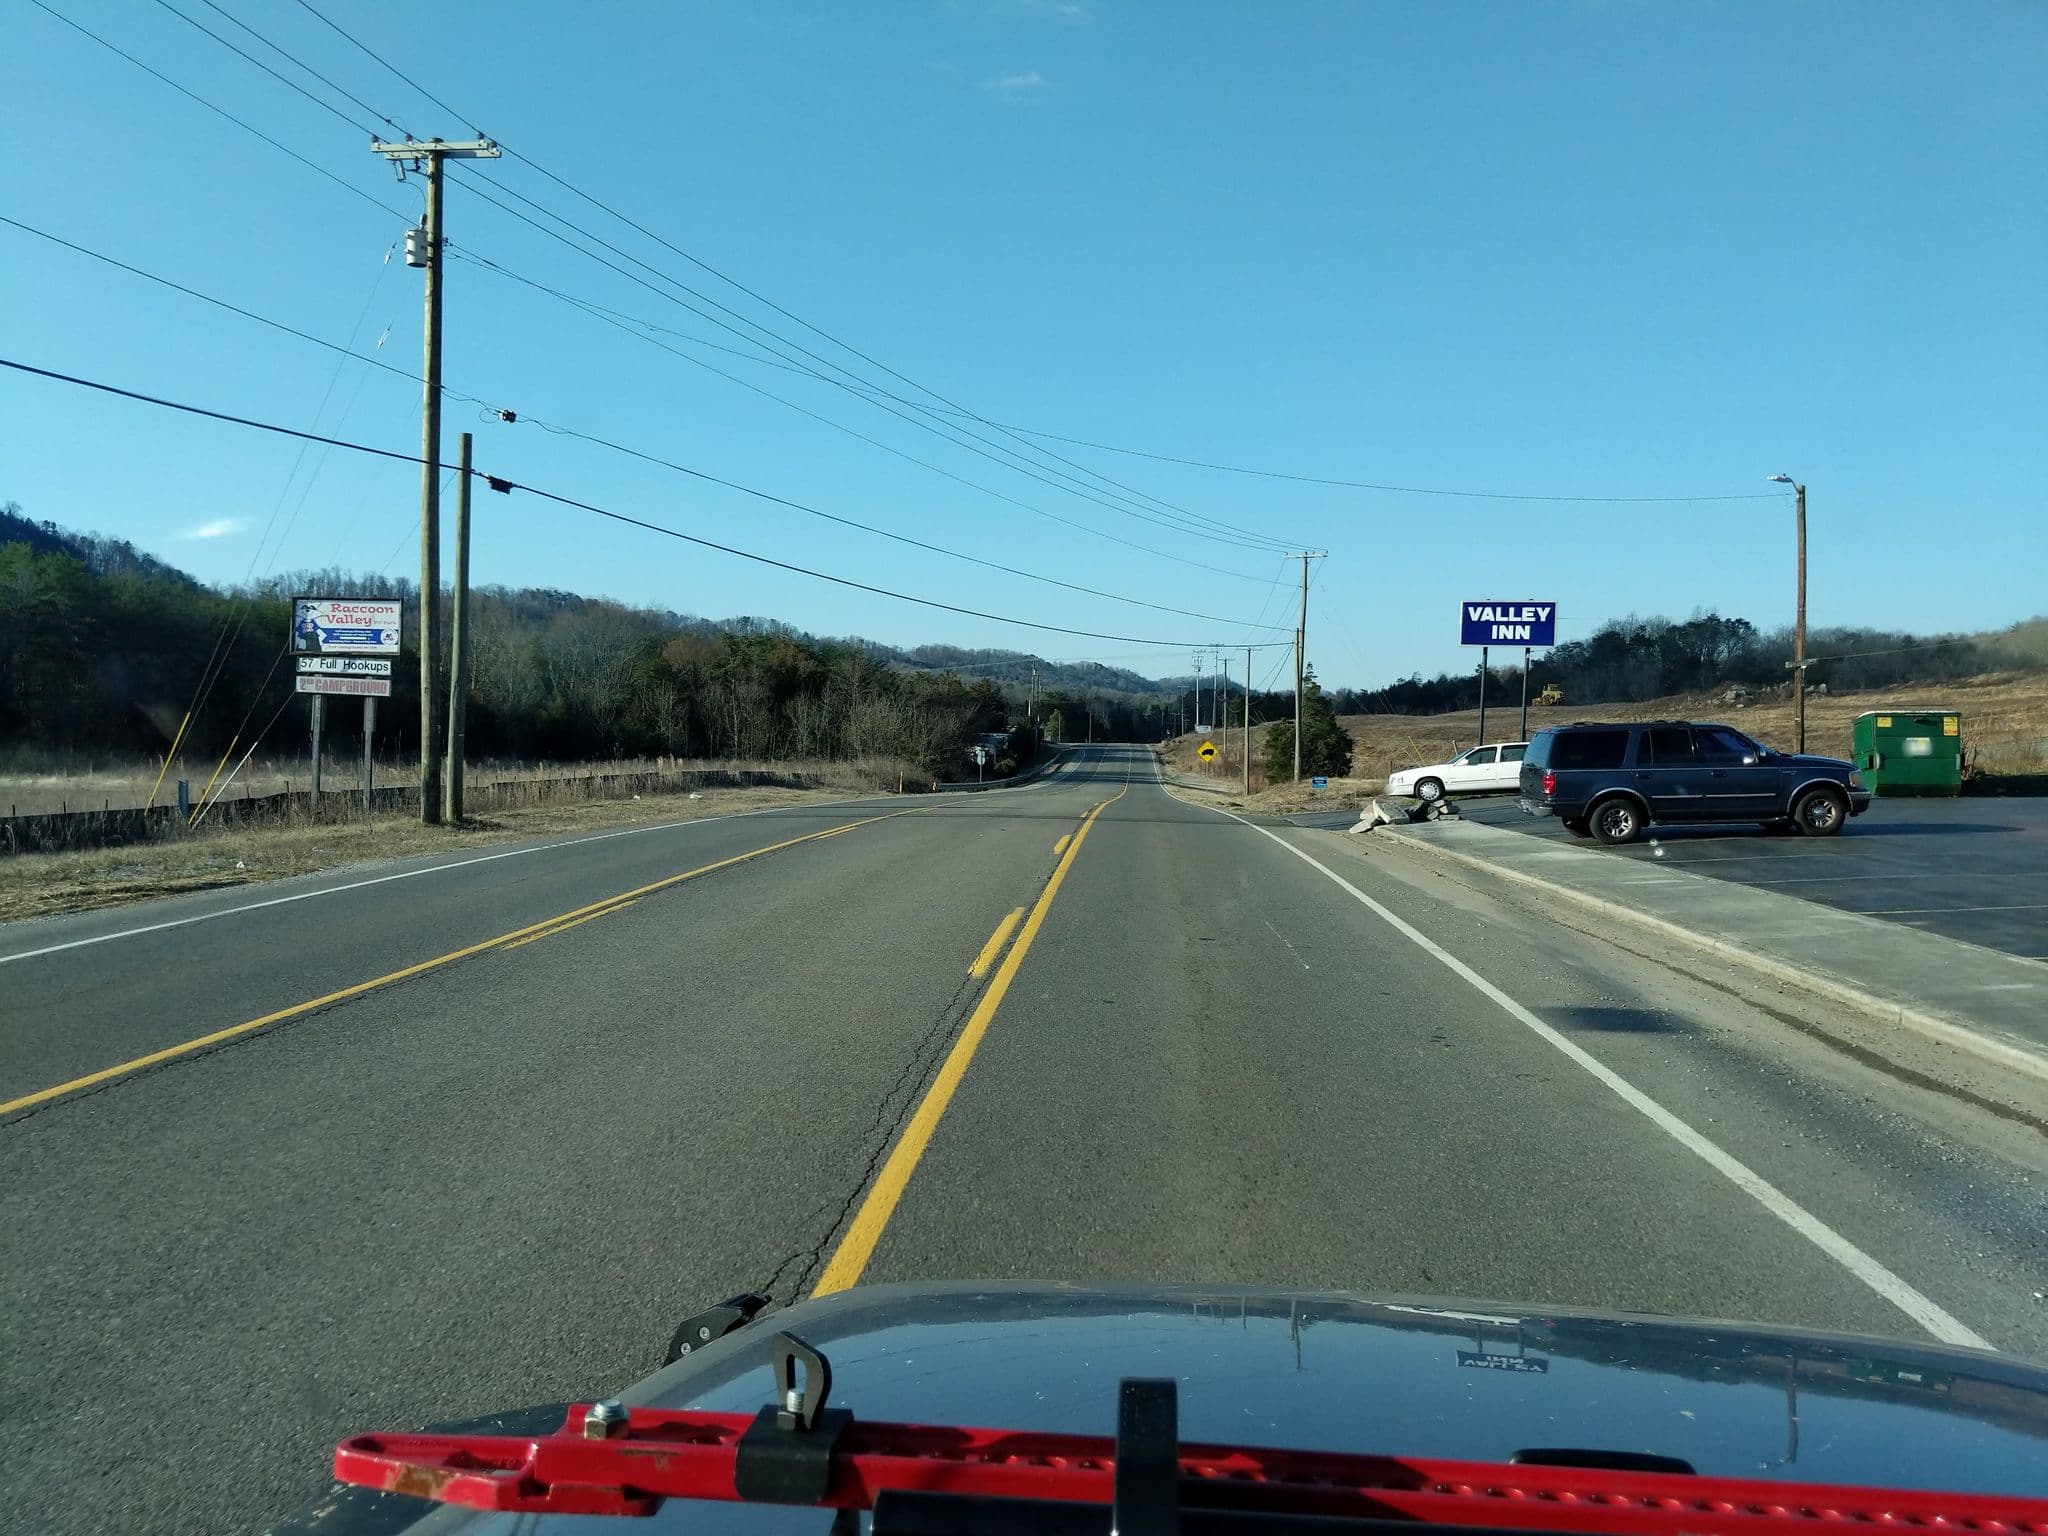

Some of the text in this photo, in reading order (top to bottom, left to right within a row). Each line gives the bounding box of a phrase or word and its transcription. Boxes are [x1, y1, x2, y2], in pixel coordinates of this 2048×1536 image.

[330, 603, 394, 613] Raccoon
[1467, 606, 1551, 622] VALLEY
[326, 614, 372, 627] Valley
[1491, 625, 1531, 640] INN
[300, 658, 389, 672] 57 Full Hookups
[315, 679, 388, 694] CAMPGROUND
